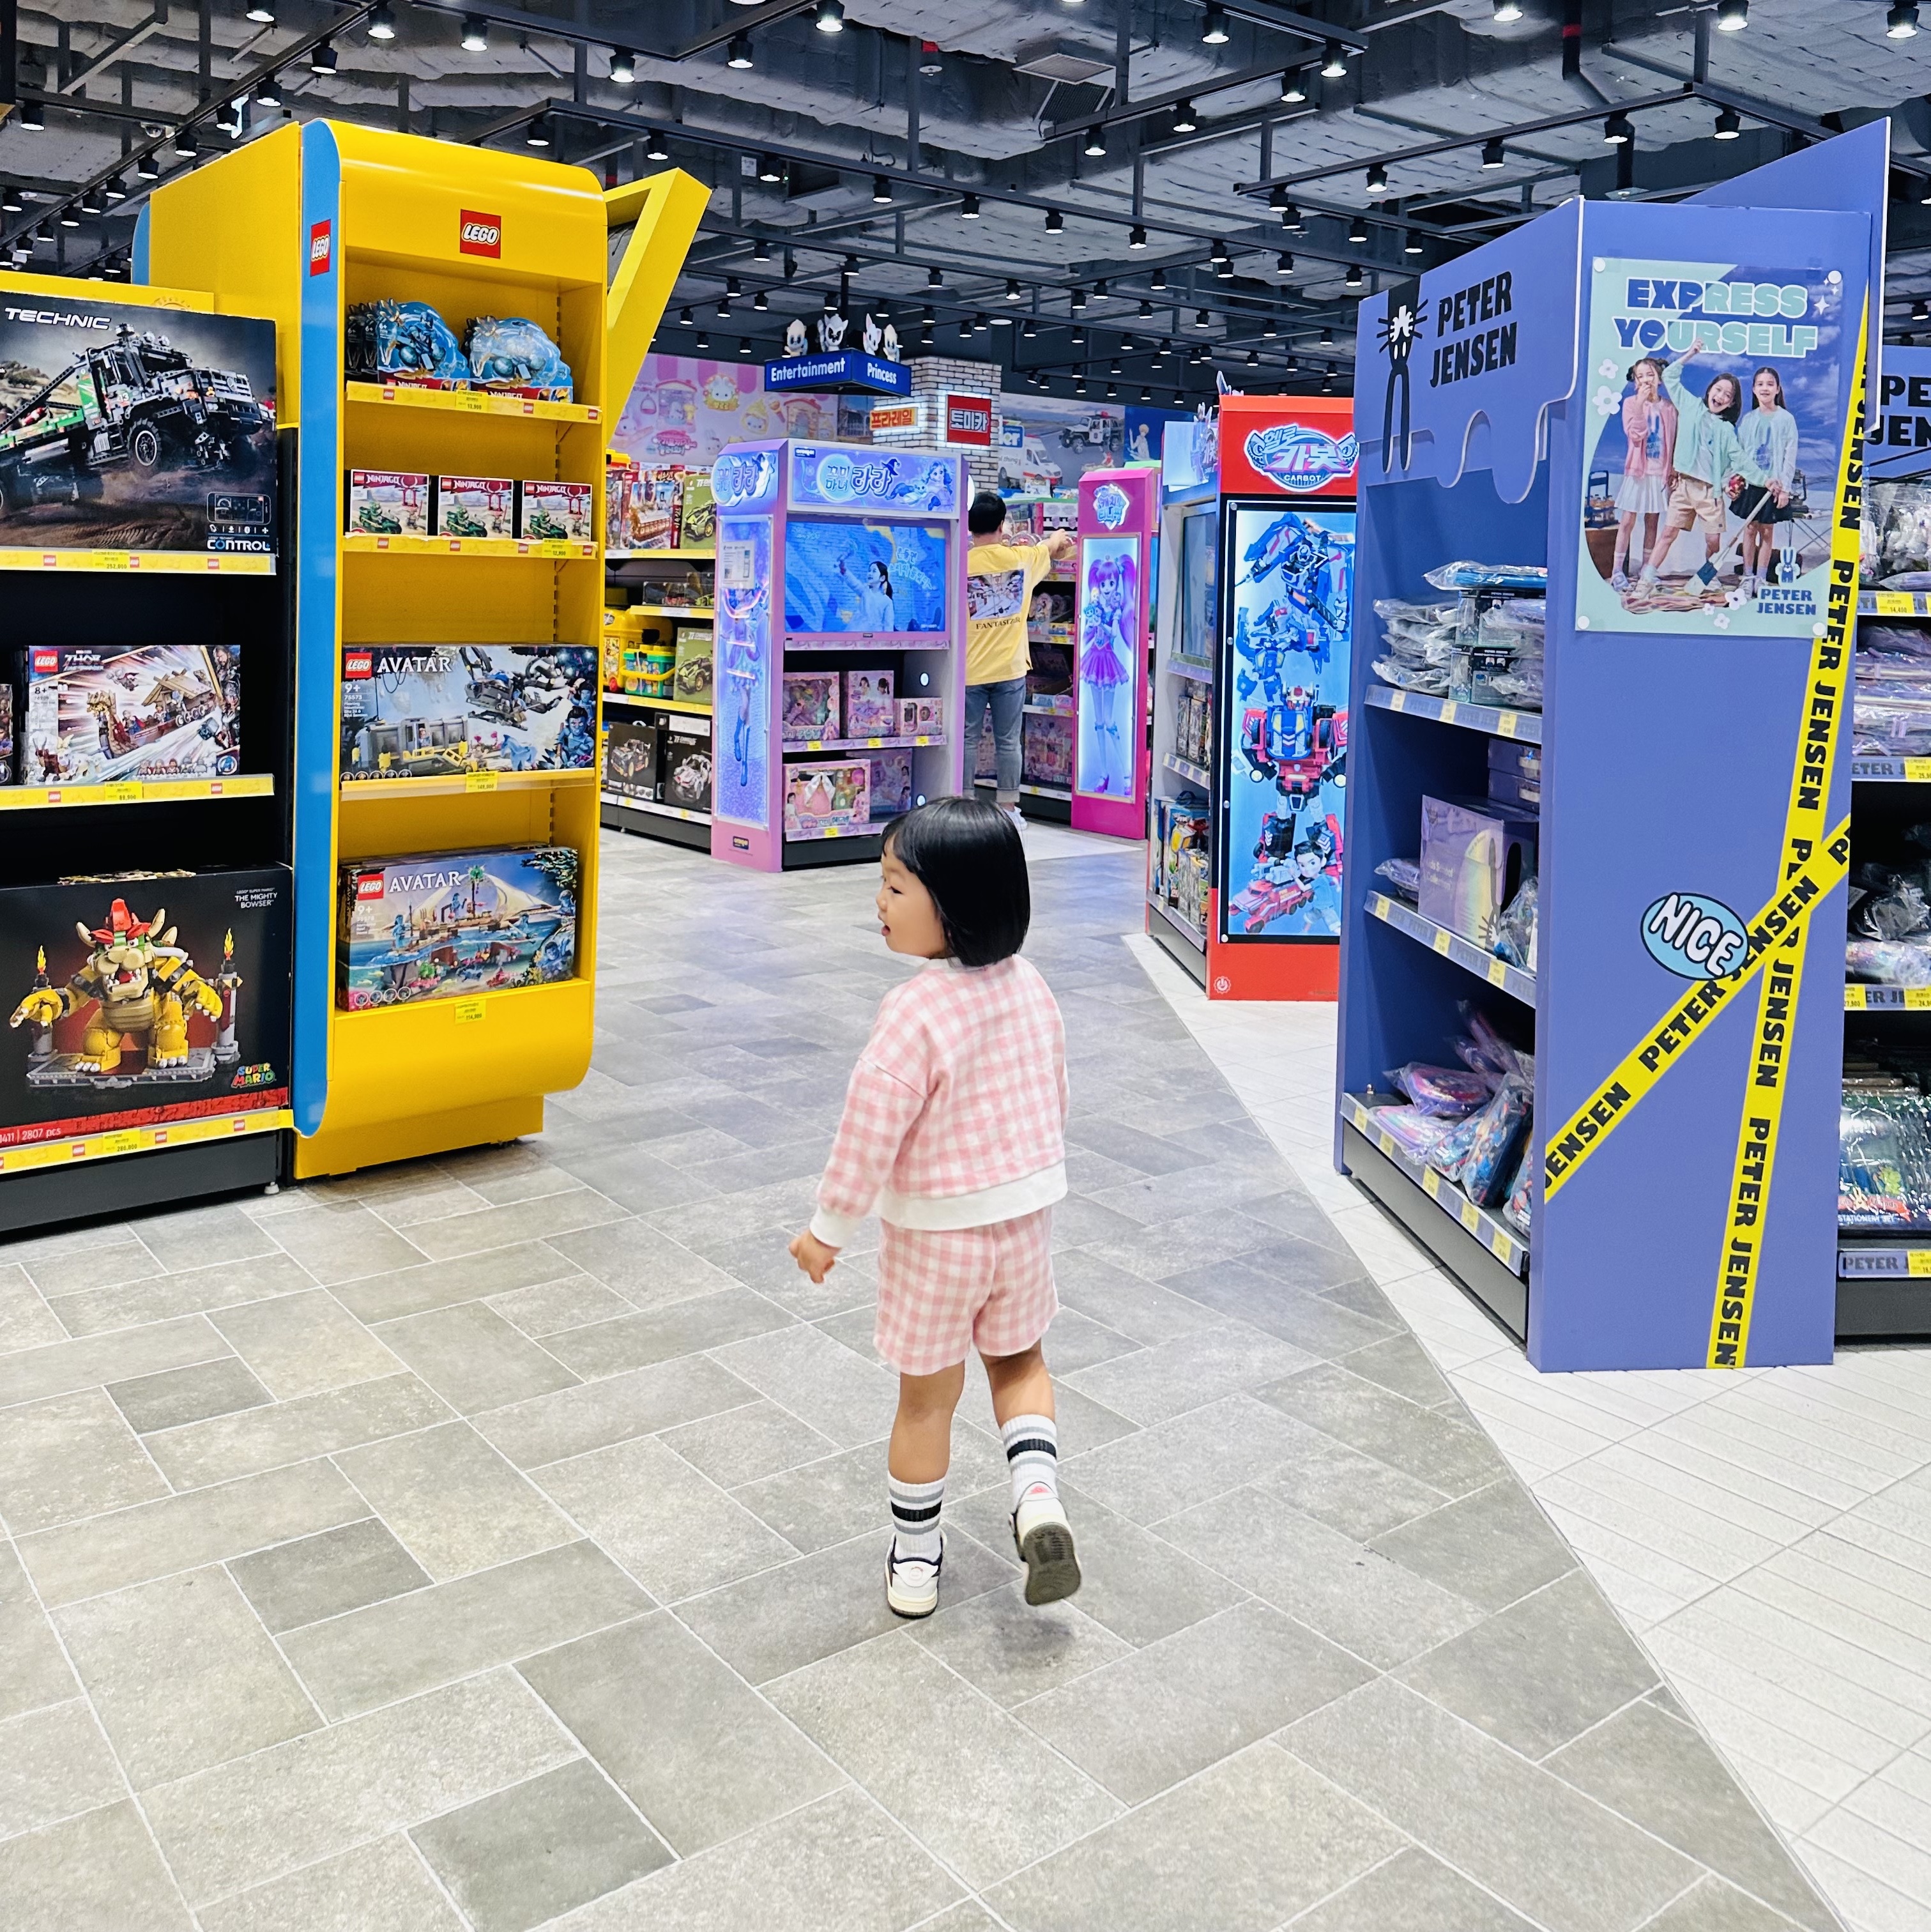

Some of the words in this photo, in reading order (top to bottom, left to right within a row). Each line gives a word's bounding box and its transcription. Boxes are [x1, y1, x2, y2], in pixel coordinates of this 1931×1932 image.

[463, 224, 500, 245] LEGO
[311, 236, 330, 261] LEGO
[1438, 272, 1512, 337] PETER
[1625, 276, 1808, 318] EXPRESS
[4, 308, 111, 330] TECHNIC
[1612, 317, 1818, 358] YOURSELF
[1430, 321, 1517, 388] JENSEN
[771, 357, 846, 382] Entertainment
[867, 362, 897, 385] Princess
[871, 410, 912, 429] 프라레일
[950, 409, 989, 431] 토미카
[1264, 426, 1297, 452] 헬로
[1274, 444, 1341, 470] 카봇
[207, 540, 270, 551] CONTROL
[1760, 588, 1812, 602] PETER
[1757, 602, 1816, 615] JENSEN
[1818, 560, 1852, 670] PETER
[36, 656, 57, 667] LEGO
[346, 658, 372, 671] LEGO
[377, 656, 452, 673] AVATAR
[345, 683, 361, 693] 9+
[1797, 680, 1836, 810] JENSEN
[360, 880, 383, 894] LEGO
[388, 871, 461, 893] AVATAR
[241, 900, 271, 908] BOWSER
[358, 905, 372, 915] 9+
[1649, 894, 1742, 976] NICE
[1638, 979, 1727, 1073] PETER
[1755, 958, 1794, 1088] JENSEN
[231, 1070, 275, 1087] MARIO
[237, 1062, 271, 1074] SUPER
[22, 1129, 43, 1139] 2807
[46, 1127, 61, 1138] pcs
[1734, 1117, 1771, 1227] PETER
[1845, 1257, 1898, 1270] PETER
[1715, 1237, 1752, 1366] JENSEN
